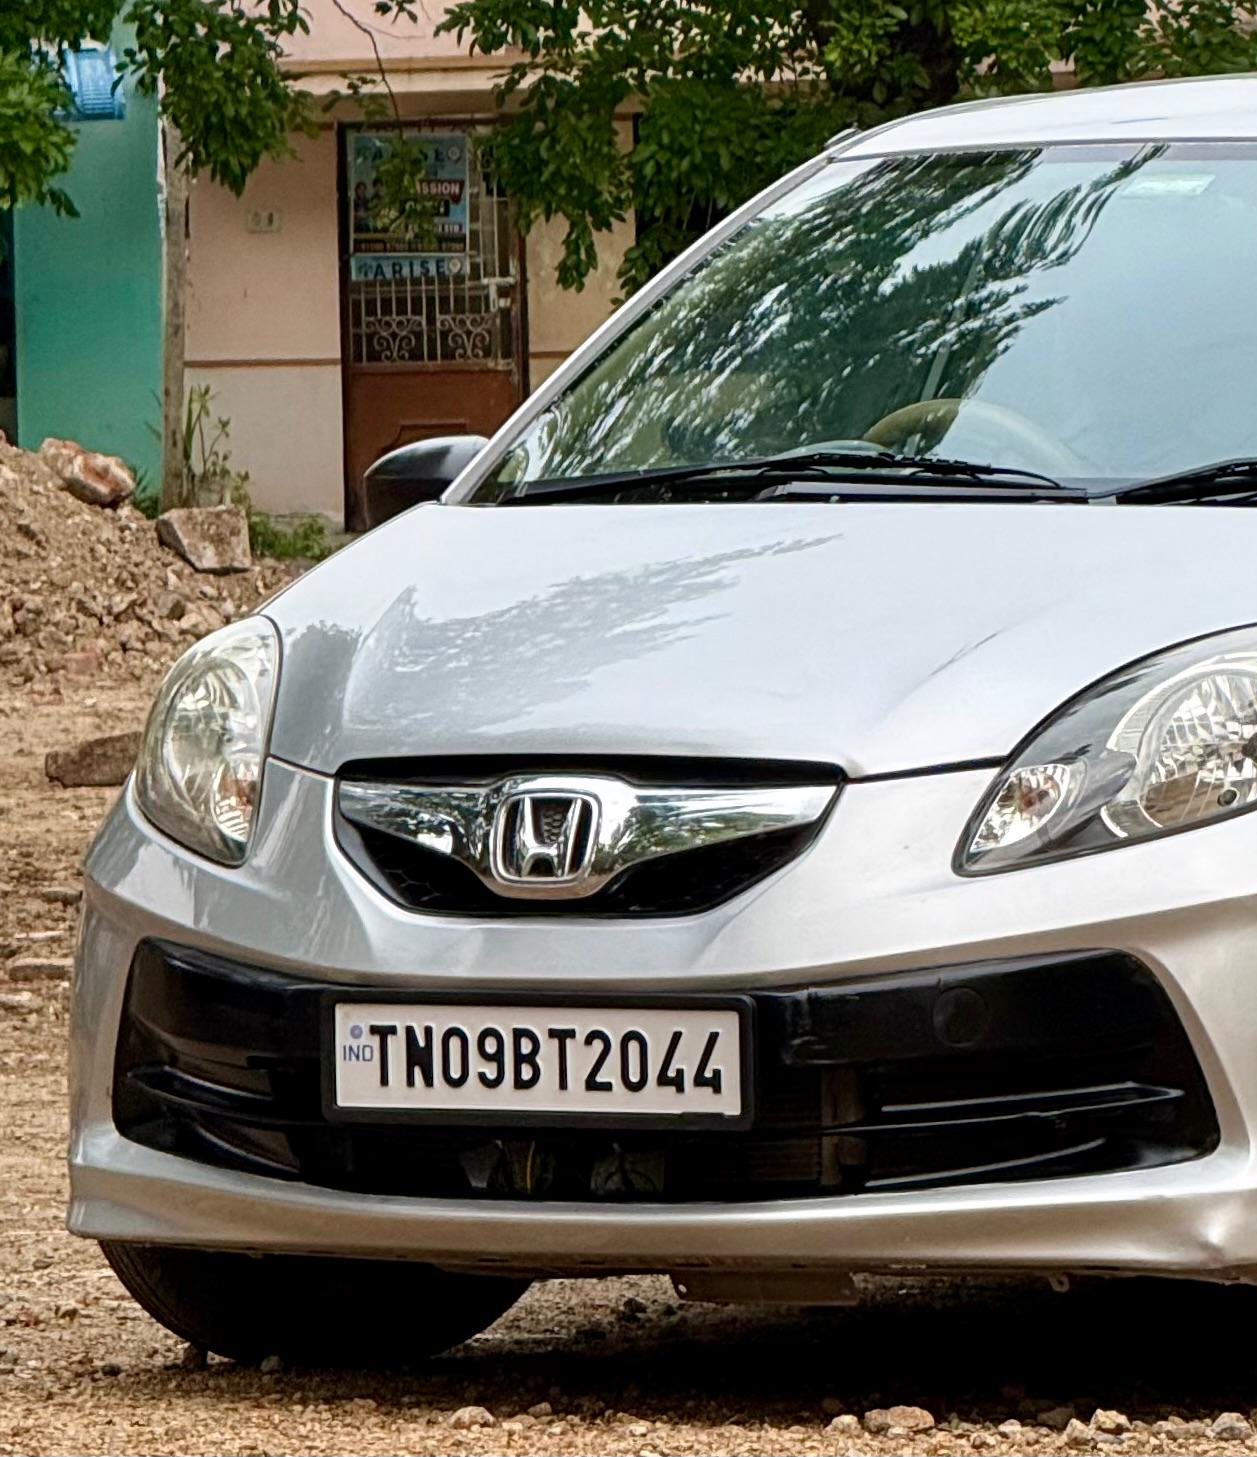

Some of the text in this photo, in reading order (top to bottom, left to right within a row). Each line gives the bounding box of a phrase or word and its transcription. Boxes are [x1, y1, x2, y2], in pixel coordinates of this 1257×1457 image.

[374, 258, 447, 280] ARISE
[343, 1044, 374, 1062] IND
[369, 1024, 723, 1094] TN09BT2044
